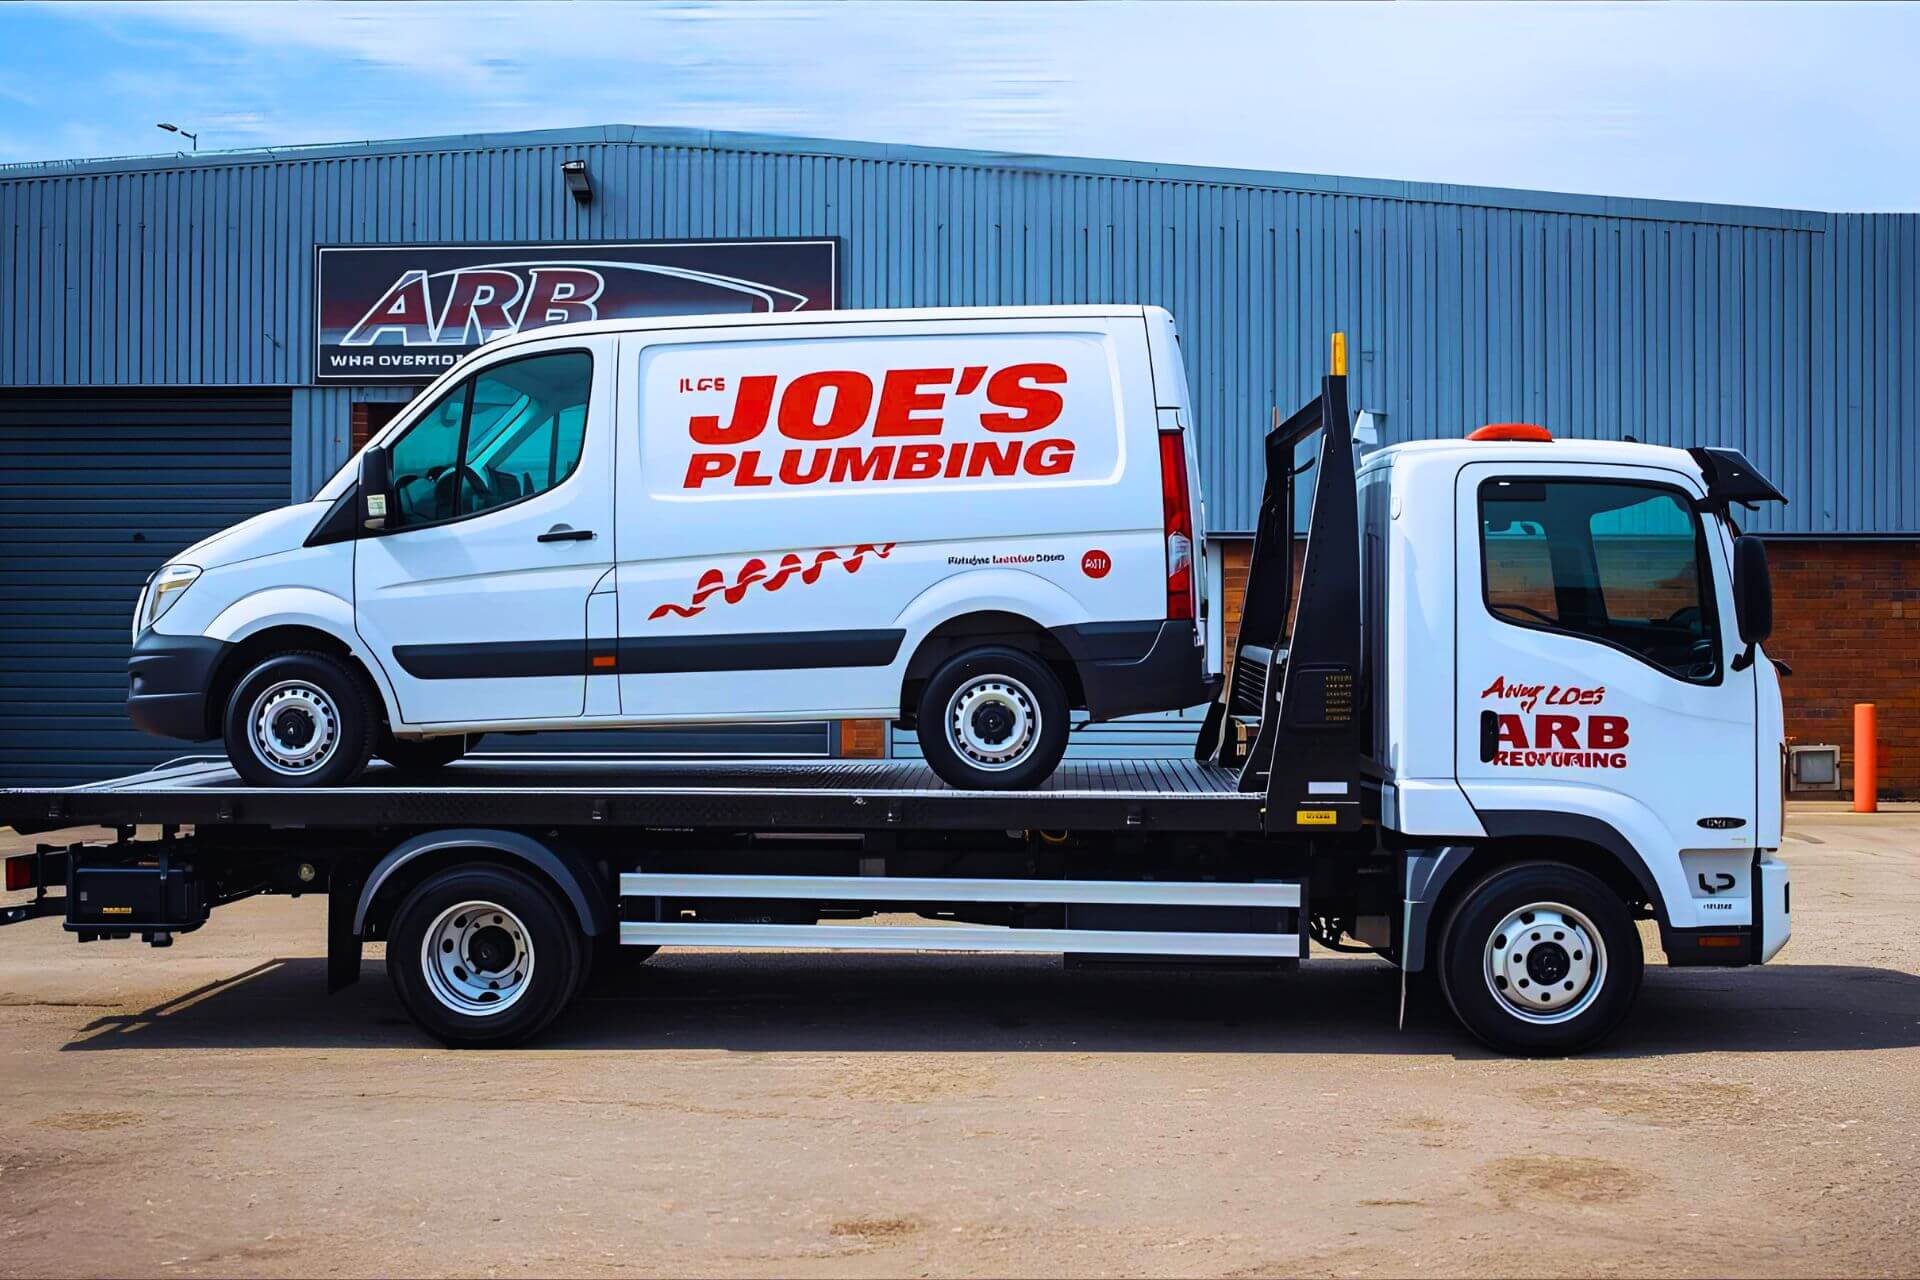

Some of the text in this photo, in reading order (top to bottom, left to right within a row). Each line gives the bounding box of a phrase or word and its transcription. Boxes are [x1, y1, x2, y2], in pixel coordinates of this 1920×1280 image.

[339, 268, 605, 346] ARB
[689, 363, 1068, 445] JOE'S
[682, 438, 1076, 489] PLUMBING
[1498, 714, 1630, 750] ARB
